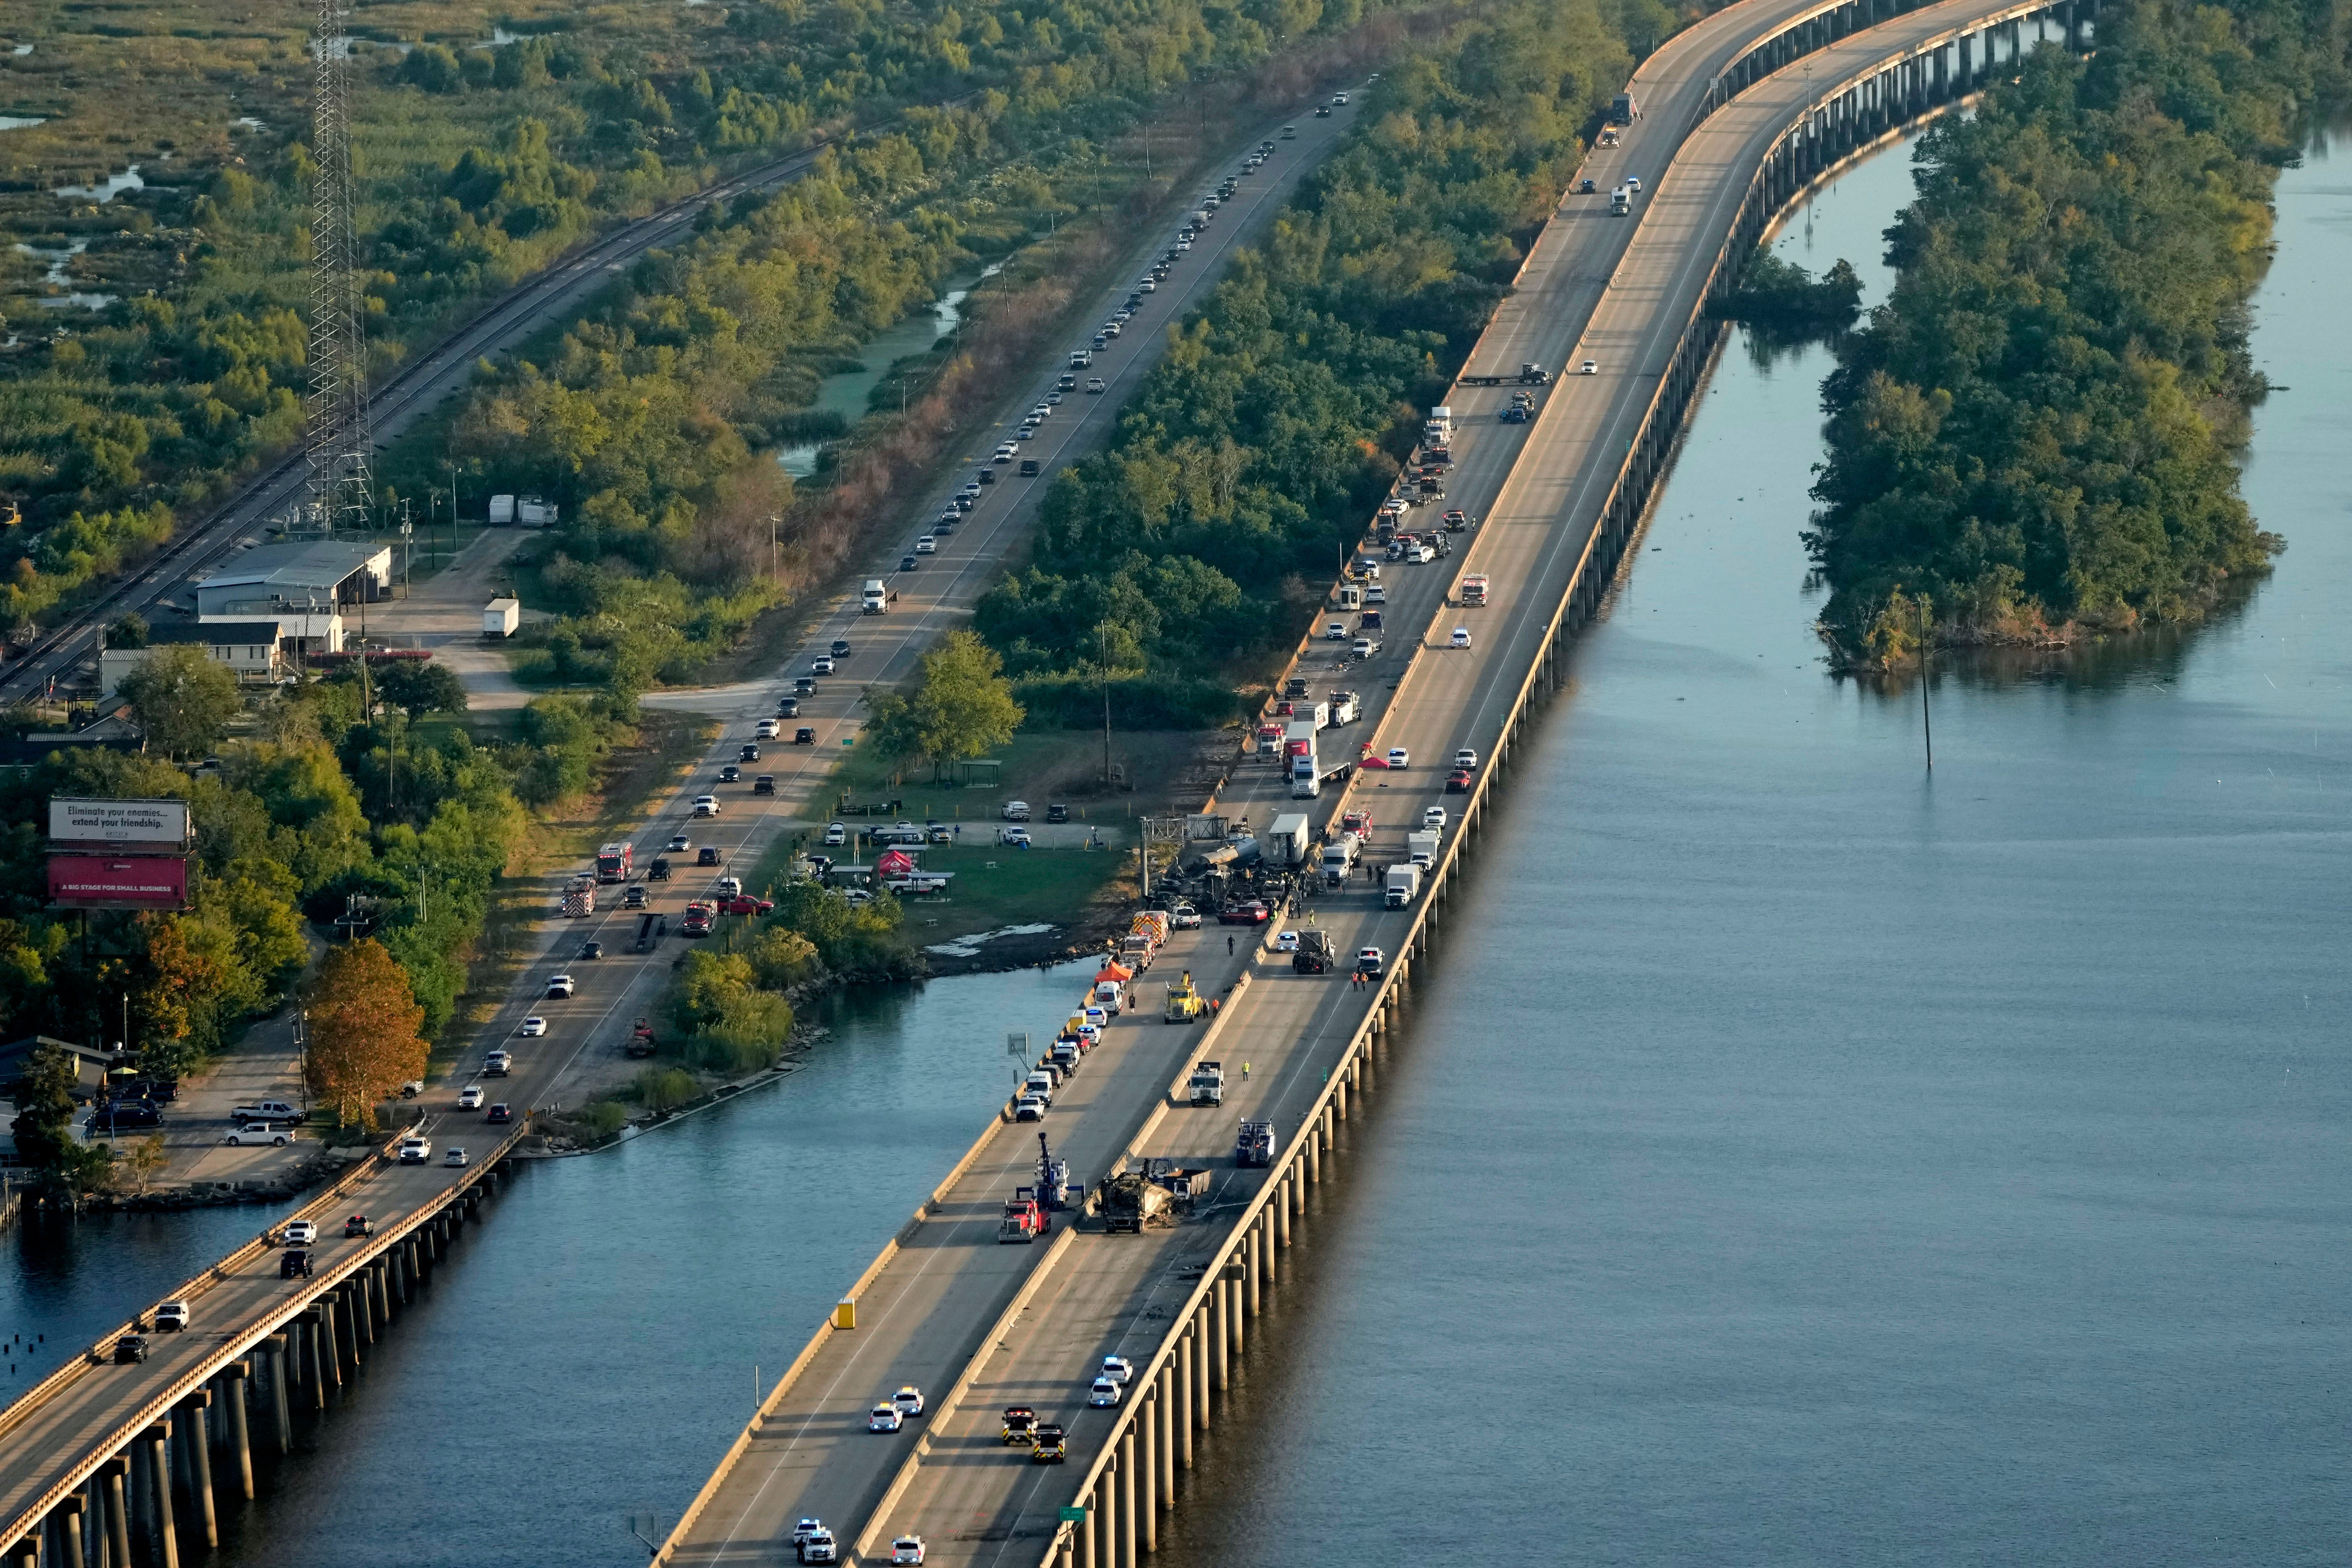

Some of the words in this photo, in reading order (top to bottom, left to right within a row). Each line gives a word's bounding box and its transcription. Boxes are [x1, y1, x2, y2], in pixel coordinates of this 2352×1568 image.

[68, 806, 105, 815] Eliminate
[127, 809, 168, 817] enemies...
[72, 818, 98, 826] extend
[101, 819, 118, 828] your
[121, 818, 163, 829] friendship.
